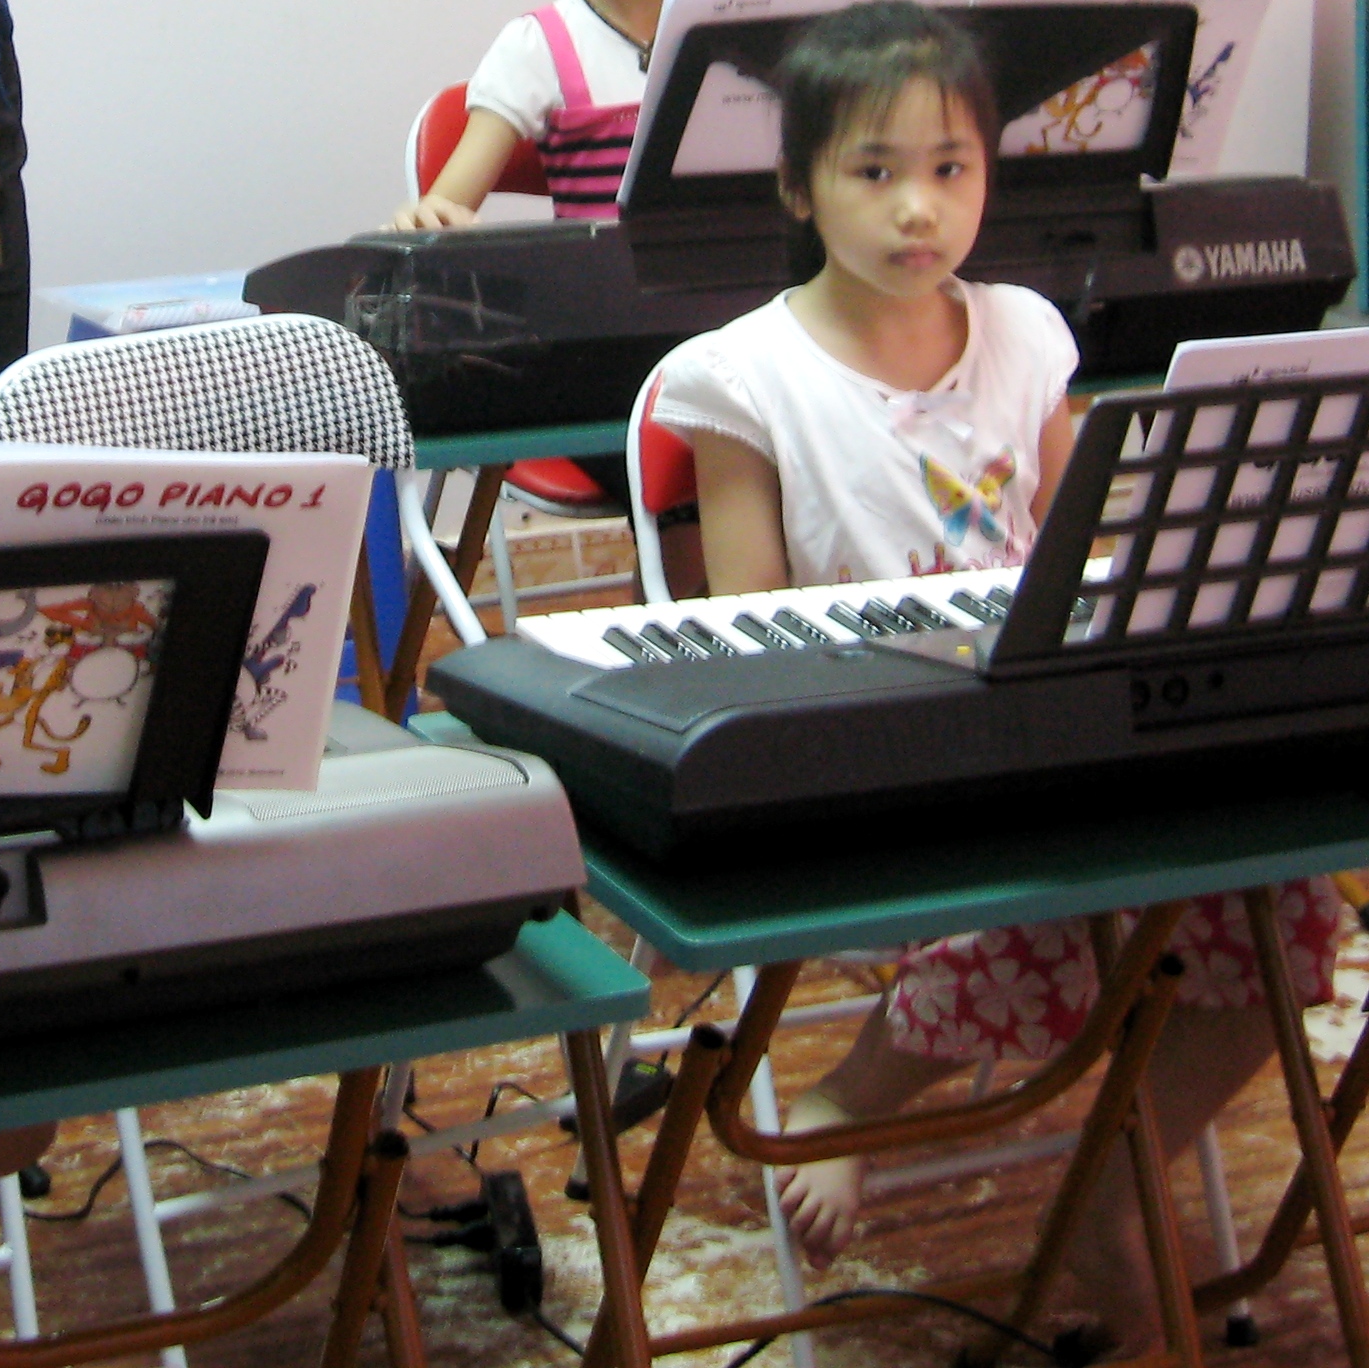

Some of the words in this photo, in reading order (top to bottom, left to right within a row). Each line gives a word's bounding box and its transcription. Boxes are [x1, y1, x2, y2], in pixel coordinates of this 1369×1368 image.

[1203, 238, 1307, 279] YAMAHA
[17, 481, 145, 515] GOGO
[158, 481, 293, 508] PIANO
[299, 483, 326, 510] 1
